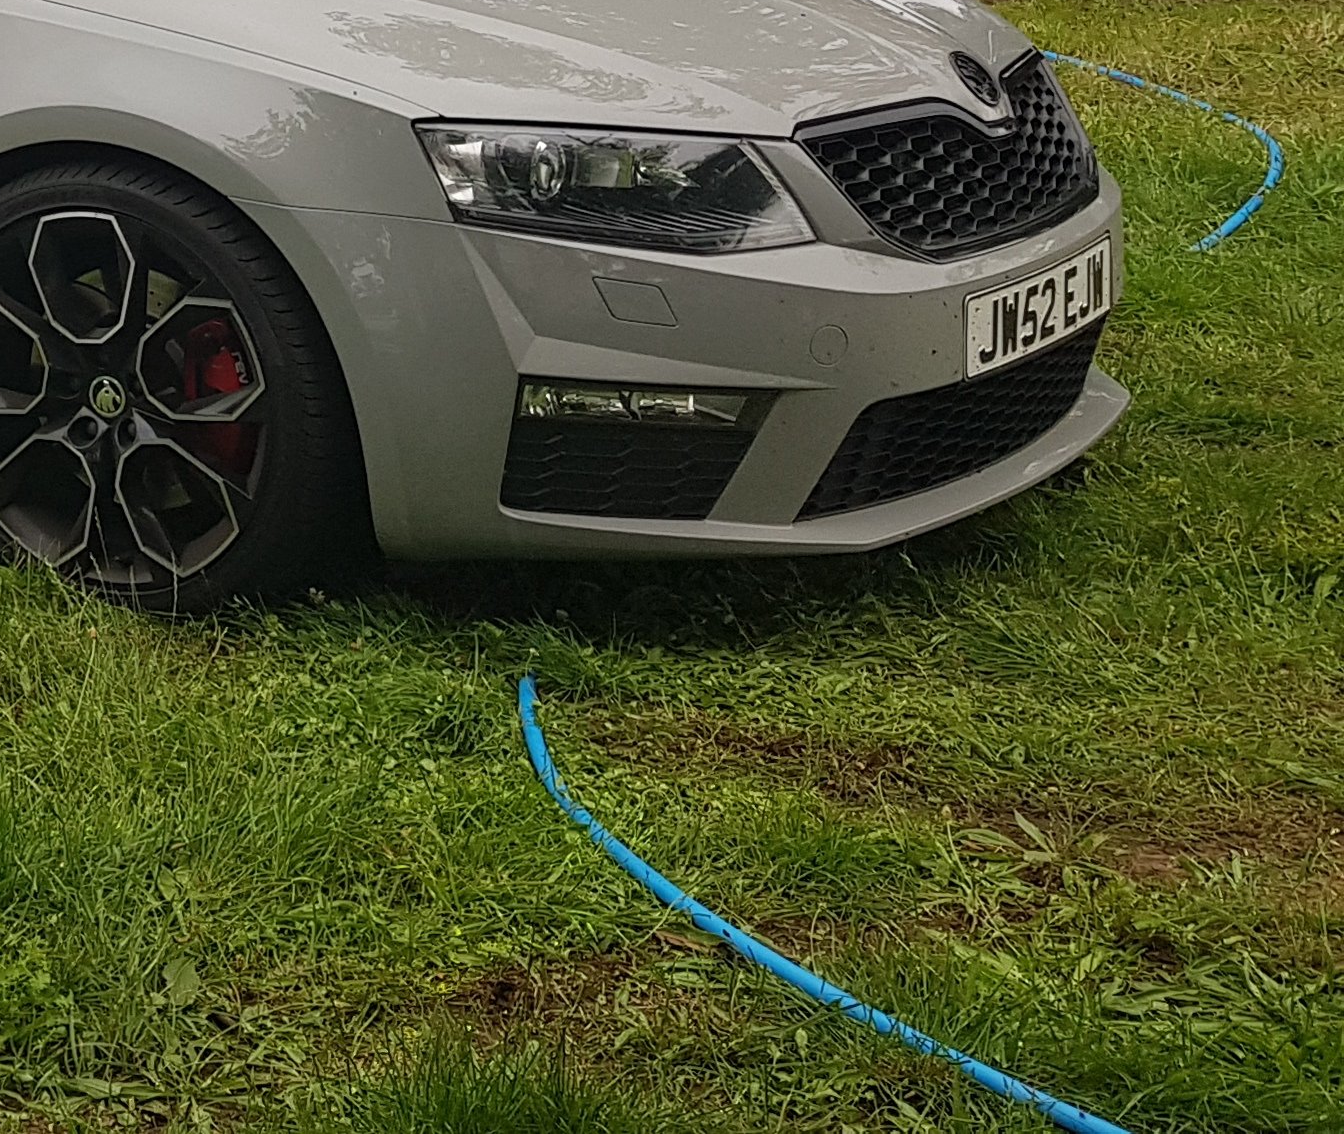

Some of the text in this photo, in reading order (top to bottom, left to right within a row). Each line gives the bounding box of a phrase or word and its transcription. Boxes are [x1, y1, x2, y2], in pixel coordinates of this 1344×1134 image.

[979, 249, 1104, 364] JW52 EJW
[231, 352, 249, 384] rev
